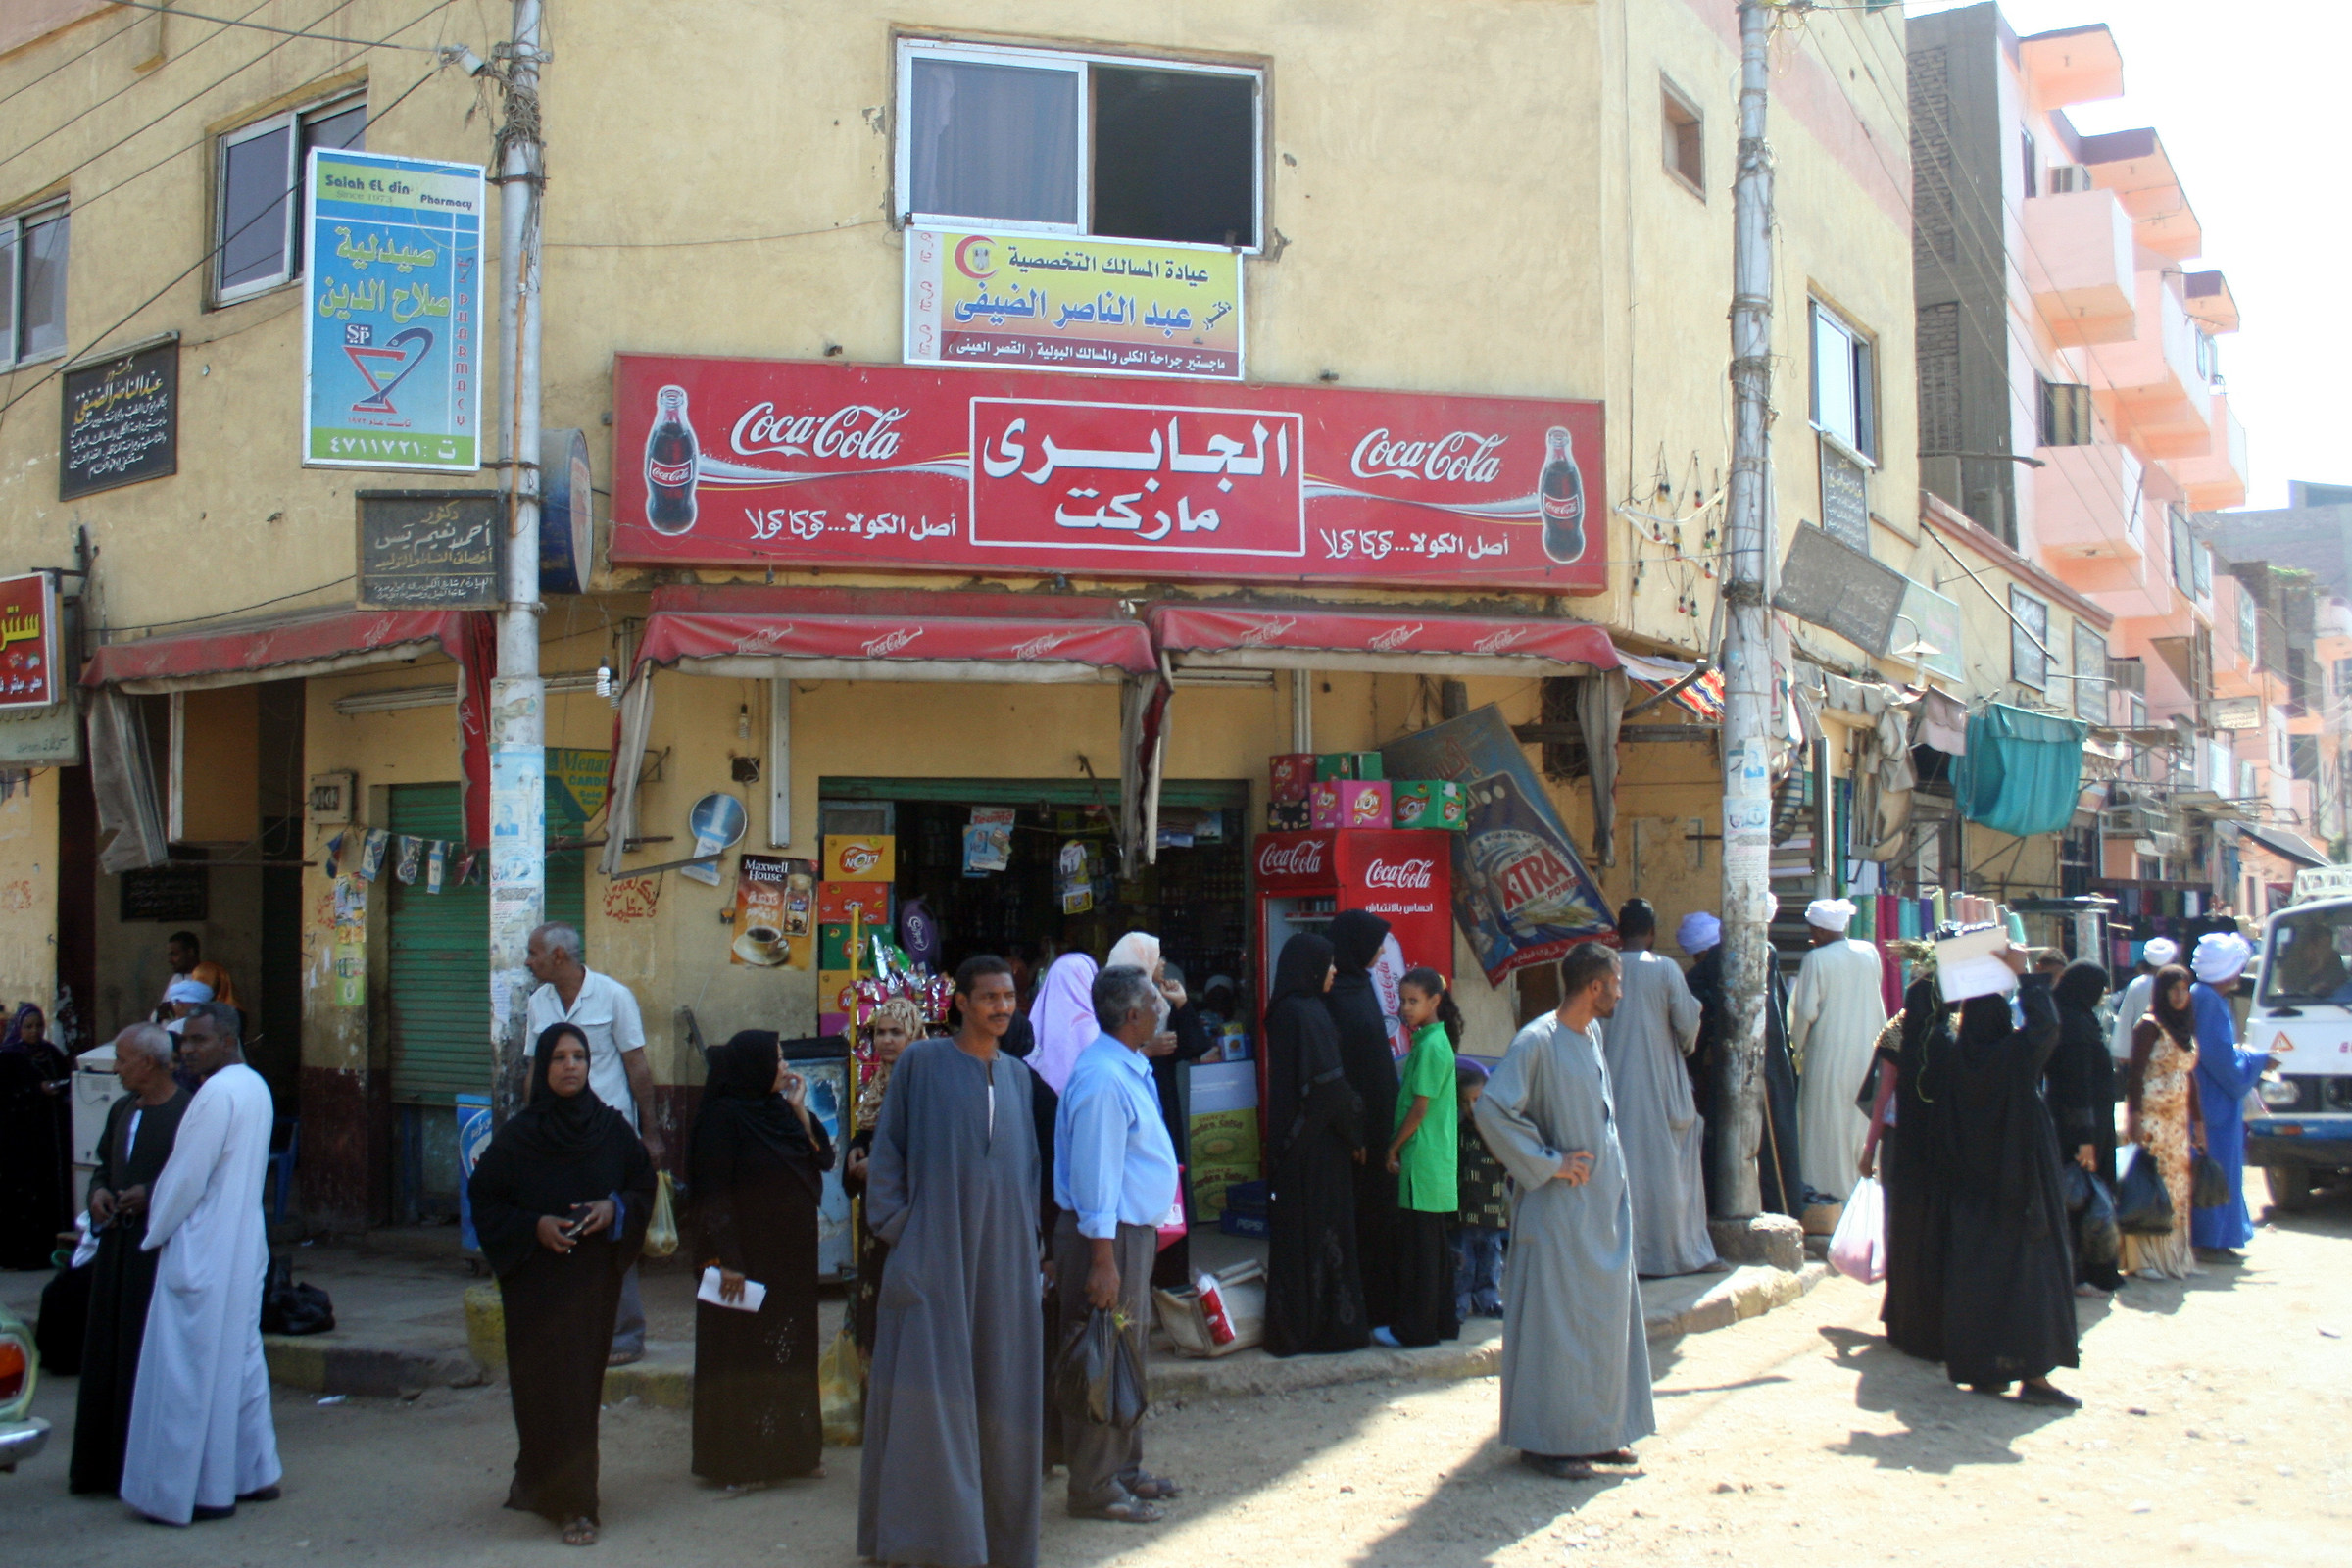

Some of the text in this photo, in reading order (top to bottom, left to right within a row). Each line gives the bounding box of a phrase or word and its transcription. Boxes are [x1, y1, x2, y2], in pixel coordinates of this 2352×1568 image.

[325, 174, 365, 190] Salah
[389, 181, 410, 194] din
[420, 194, 472, 211] Pharmacy
[334, 226, 437, 273] صيدلية
[1008, 245, 1209, 286] عيادة المسالك التخصصية
[319, 276, 451, 324] صلاح الدين
[953, 280, 1194, 339] عبد الناصر الضيفى
[956, 338, 991, 355] العينى
[993, 340, 1026, 357] القصر
[1037, 343, 1073, 361] البولية
[1076, 347, 1117, 364] والمسالك
[1120, 350, 1148, 366] الكلى
[455, 293, 469, 426] PHARMACY
[1149, 351, 1183, 369] جراحة
[1185, 355, 1226, 371] ماجستير
[730, 401, 911, 460] Coca-Cola
[330, 436, 420, 457] ٤٧١١٧٢١
[982, 415, 1289, 493] الجابرى
[1350, 427, 1509, 483] Coca-Cola
[651, 465, 690, 482] Coca-Cola
[909, 512, 957, 540] أصل
[1054, 487, 1221, 541] ماركت
[448, 518, 492, 551] أحمد
[1468, 532, 1509, 560] أصل
[1354, 793, 1380, 810] LION
[744, 859, 790, 873] Maxwell
[845, 853, 880, 870] LION
[1259, 840, 1326, 876] Coca-Cola
[749, 869, 784, 882] House
[1365, 858, 1435, 889] Coca-Cola
[1493, 847, 1573, 911] XTRA
